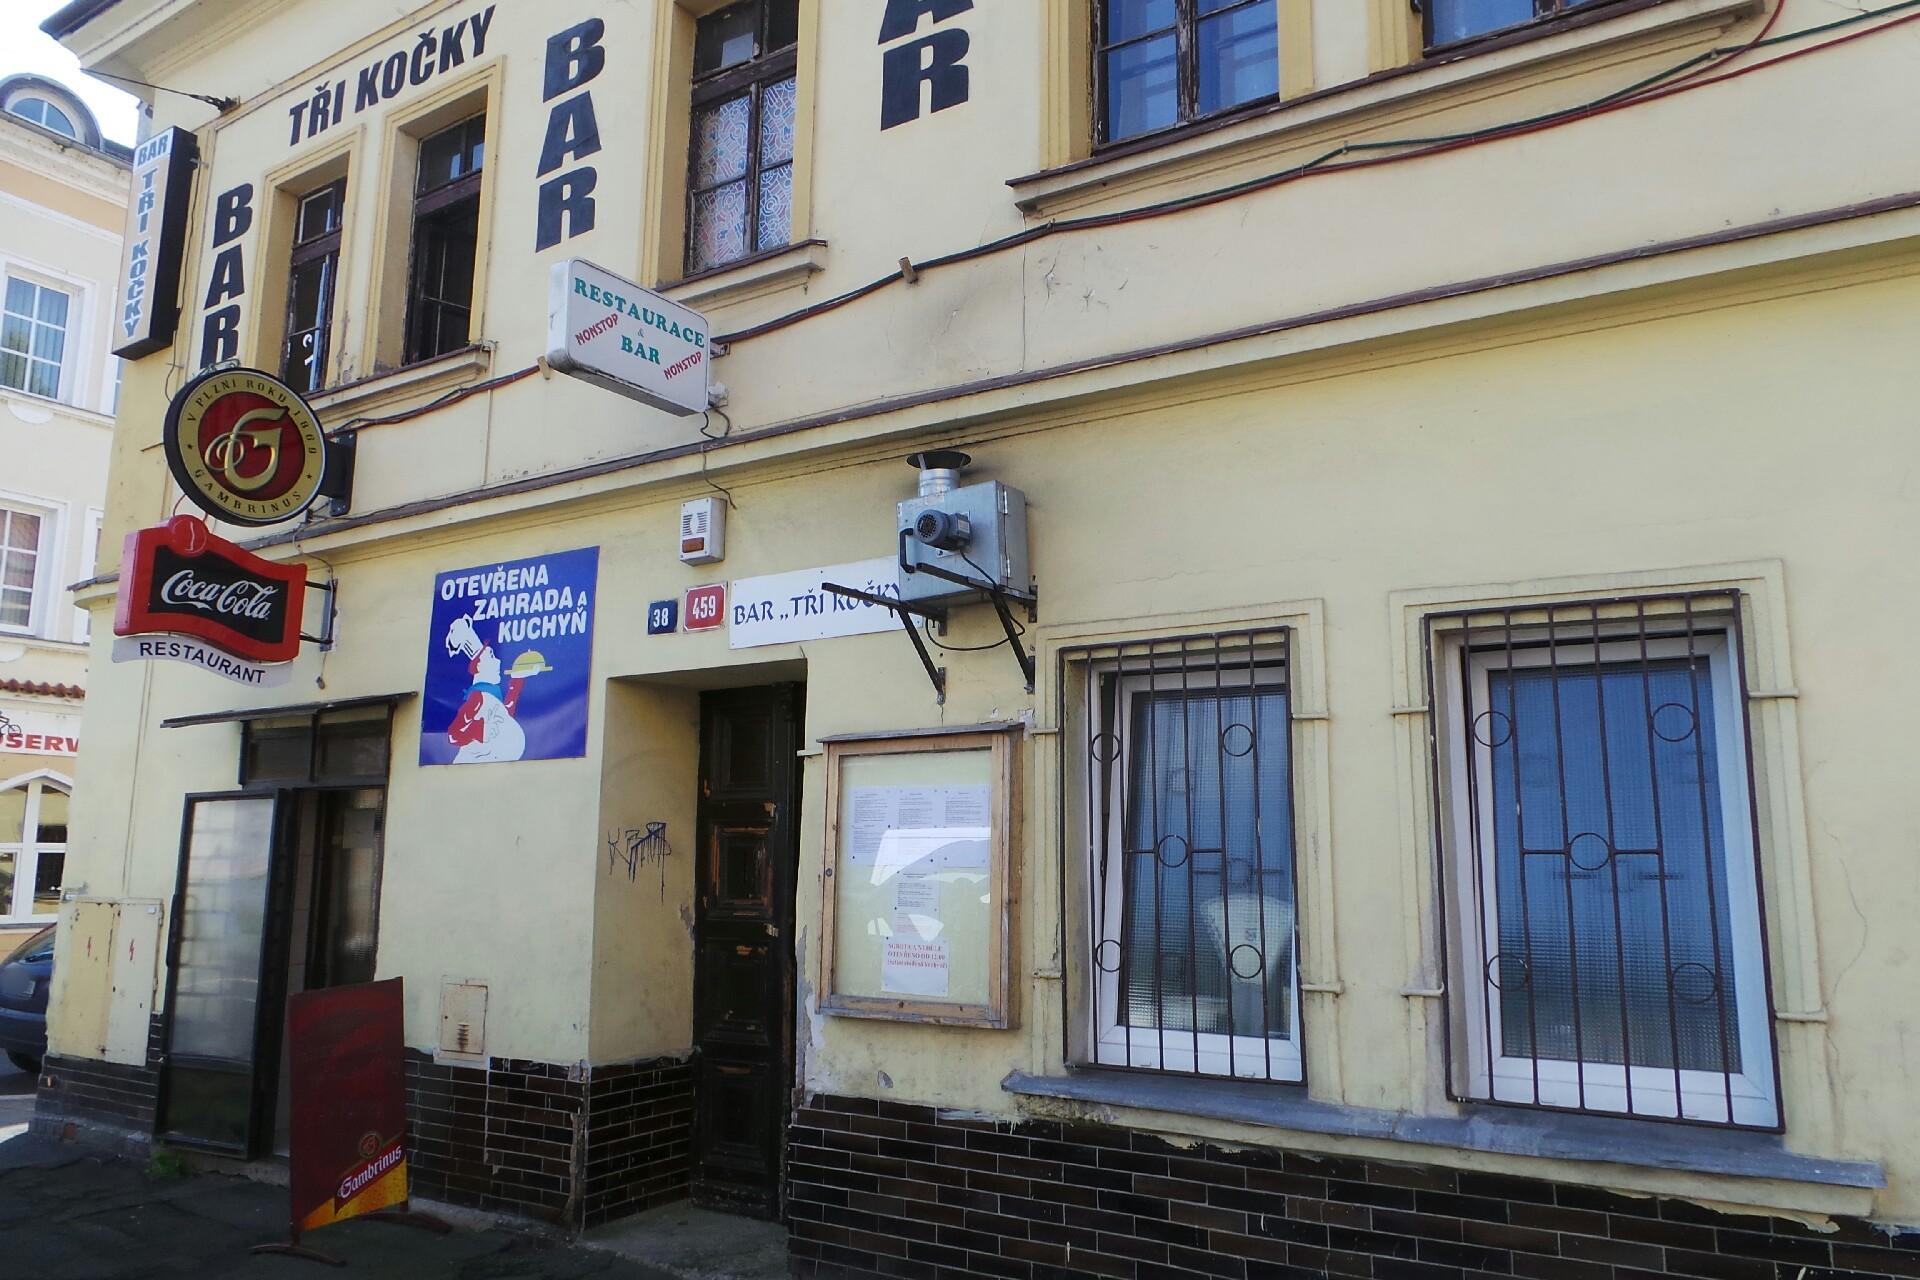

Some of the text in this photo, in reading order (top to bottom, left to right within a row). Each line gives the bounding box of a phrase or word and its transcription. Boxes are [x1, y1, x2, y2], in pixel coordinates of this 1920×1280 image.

[289, 4, 496, 147] TŘI KOČKY
[137, 134, 168, 167] BAR
[536, 18, 605, 253] BAR
[200, 183, 253, 369] BAR
[574, 277, 705, 348] RESTAURACE
[575, 313, 619, 345] NONSTOP
[621, 335, 661, 365] BAR
[664, 351, 702, 380] NONSTOP
[195, 379, 237, 407] PLZNI
[246, 380, 287, 403] ROKU
[195, 469, 302, 514] GAMBRINUS
[161, 569, 279, 620] Coca-Cola
[441, 564, 549, 601] OTEVŘENA
[473, 586, 588, 621] ZAHRADA A
[652, 608, 669, 628] 38
[692, 594, 717, 620] 459
[733, 600, 774, 625] BAR
[498, 606, 588, 644] KUCHYŇ
[139, 641, 265, 684] RESTAURANT
[0, 733, 79, 752] SERV
[337, 1145, 402, 1198] Gambrinus
